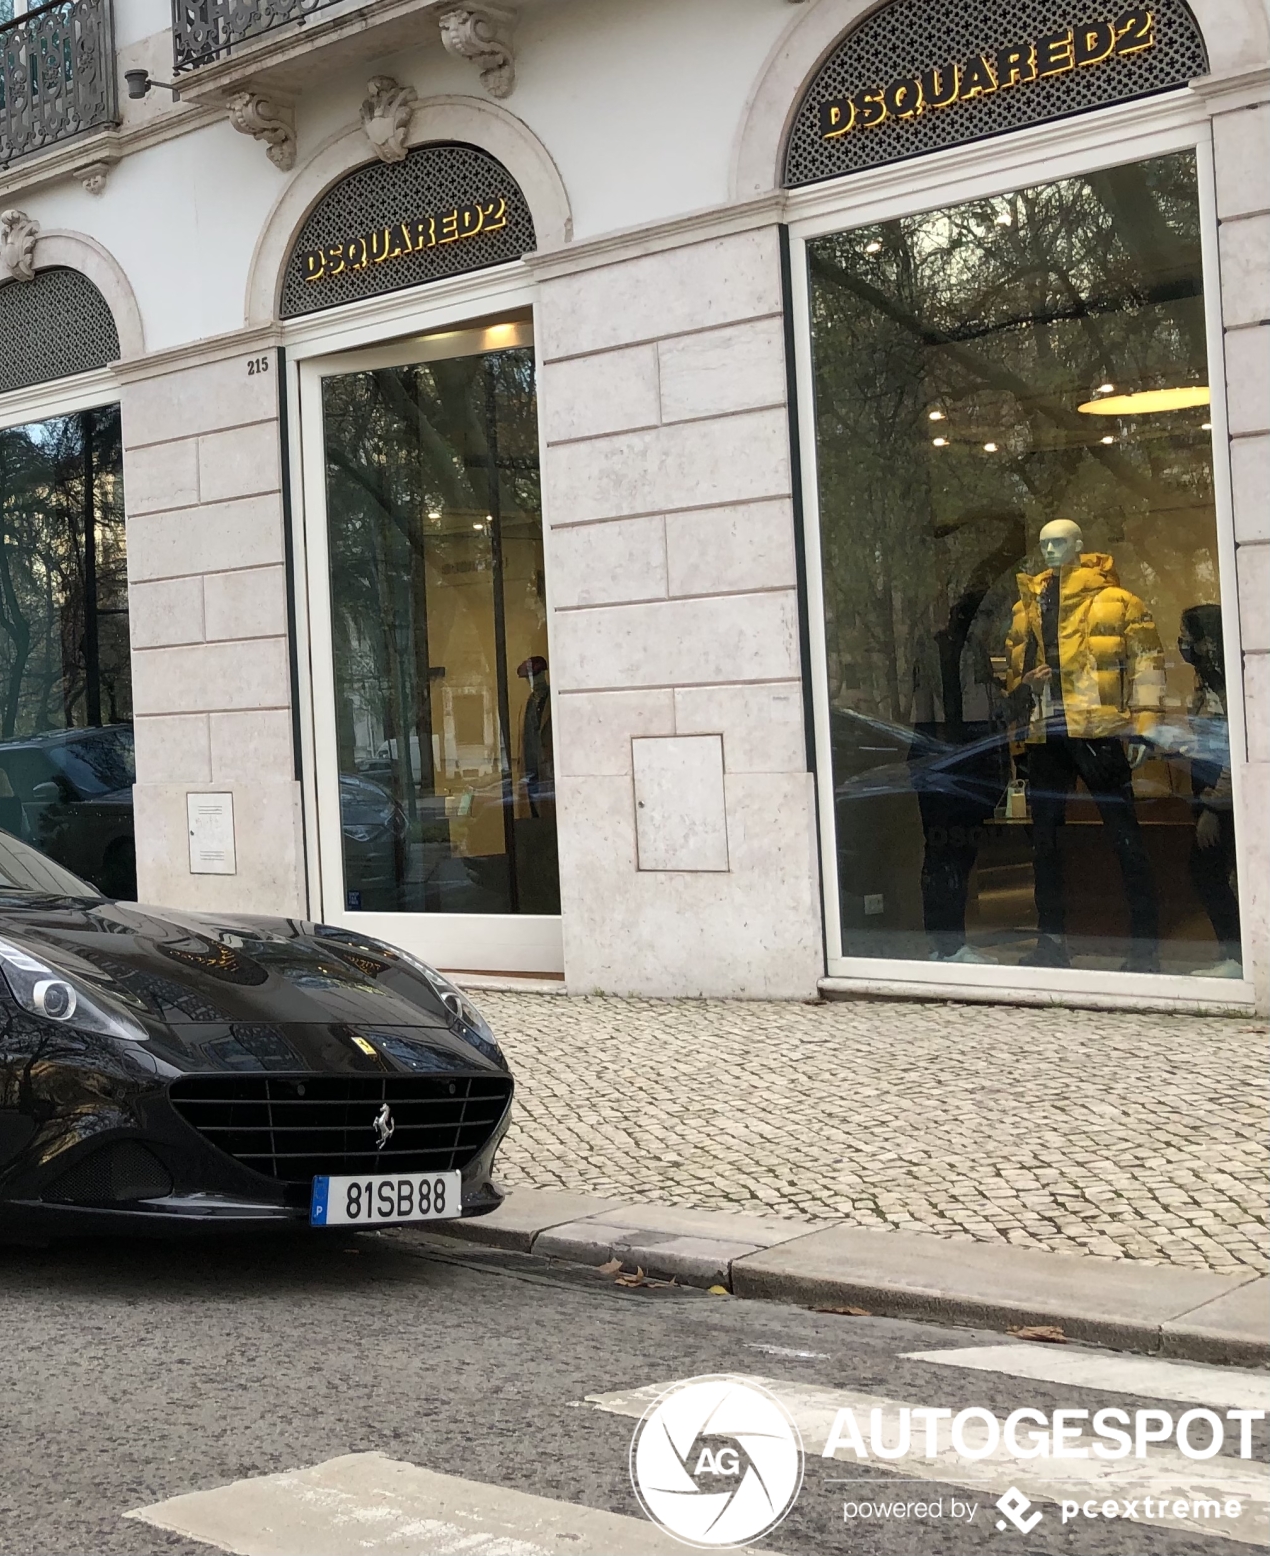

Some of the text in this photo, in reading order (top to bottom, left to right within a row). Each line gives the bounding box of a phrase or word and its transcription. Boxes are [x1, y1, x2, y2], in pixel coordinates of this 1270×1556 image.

[819, 8, 1153, 138] DSQUARED2
[301, 196, 506, 281] DSQUARED2
[247, 356, 269, 376] 215
[316, 1205, 323, 1216] P
